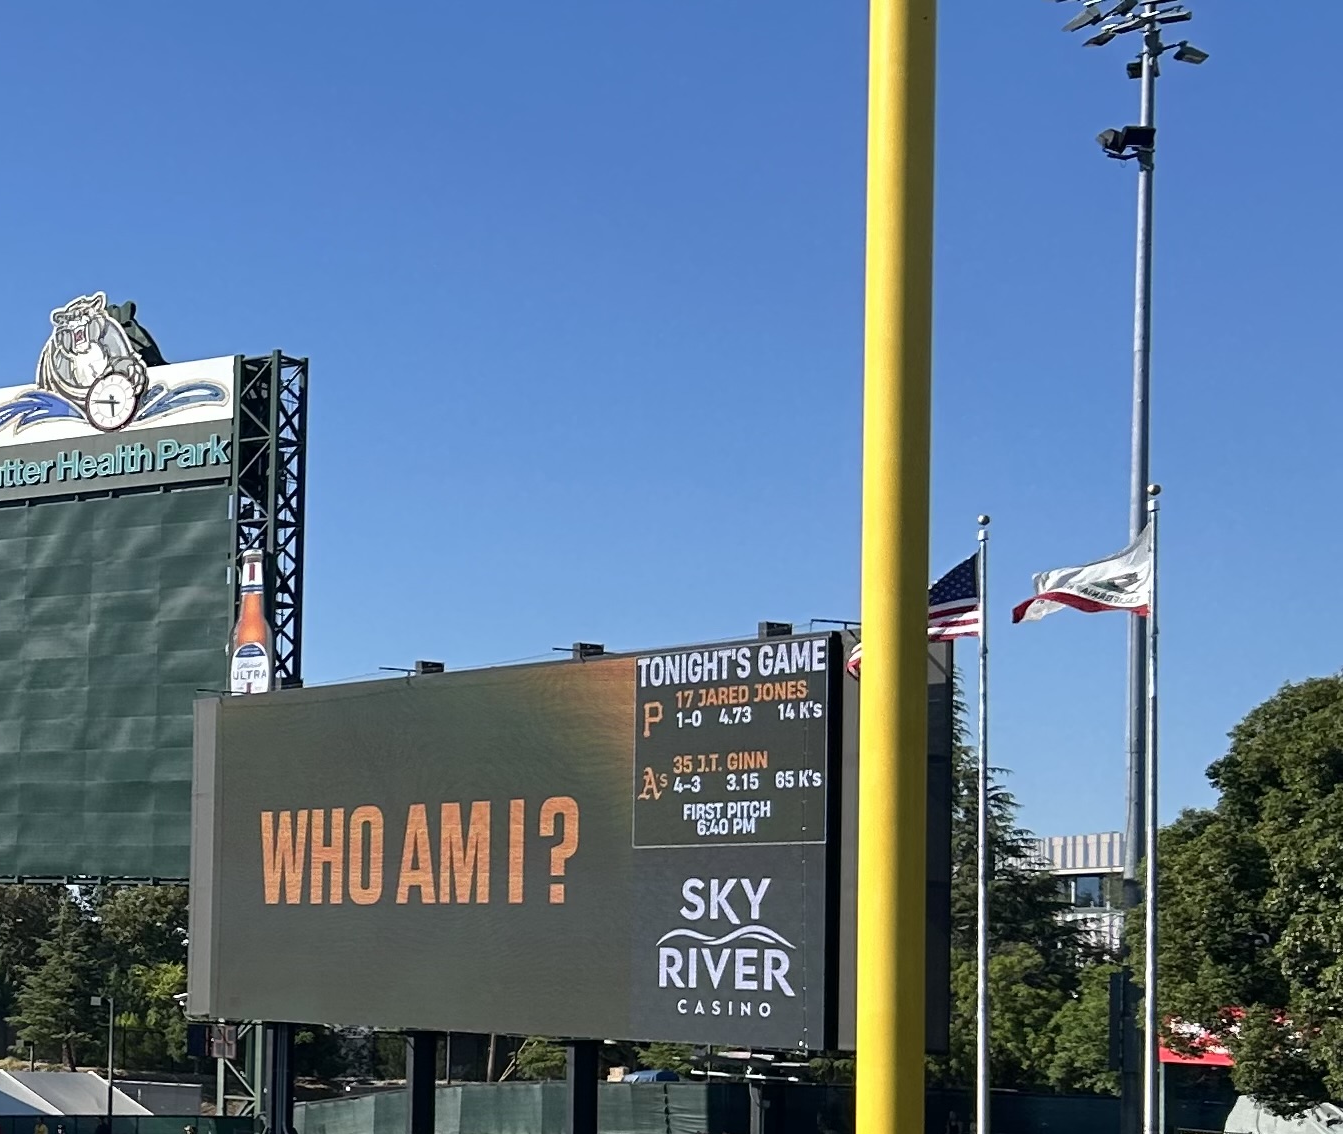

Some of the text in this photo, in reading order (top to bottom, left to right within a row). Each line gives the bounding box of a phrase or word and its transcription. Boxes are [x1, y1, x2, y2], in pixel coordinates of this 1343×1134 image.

[56, 443, 153, 481] Health
[157, 434, 232, 471] Park
[233, 669, 266, 680] ULTRA
[637, 639, 826, 687] TONIGHT'S GAME
[675, 680, 808, 708] 17 JARED JONES
[642, 701, 663, 738] P
[676, 700, 823, 728] 1-0 4.73 14 K's
[673, 751, 769, 774] 35 J.T. GINN
[637, 766, 668, 800] A's
[673, 769, 822, 793] 4-3 3.15 65 K's
[683, 801, 771, 820] FIRST PITCH
[696, 818, 756, 836] 6:40 PM
[260, 805, 383, 905] WHO
[396, 800, 490, 905] AM
[680, 877, 771, 924] SKY
[658, 946, 797, 998] RIVER
[676, 999, 772, 1017] CASINO
